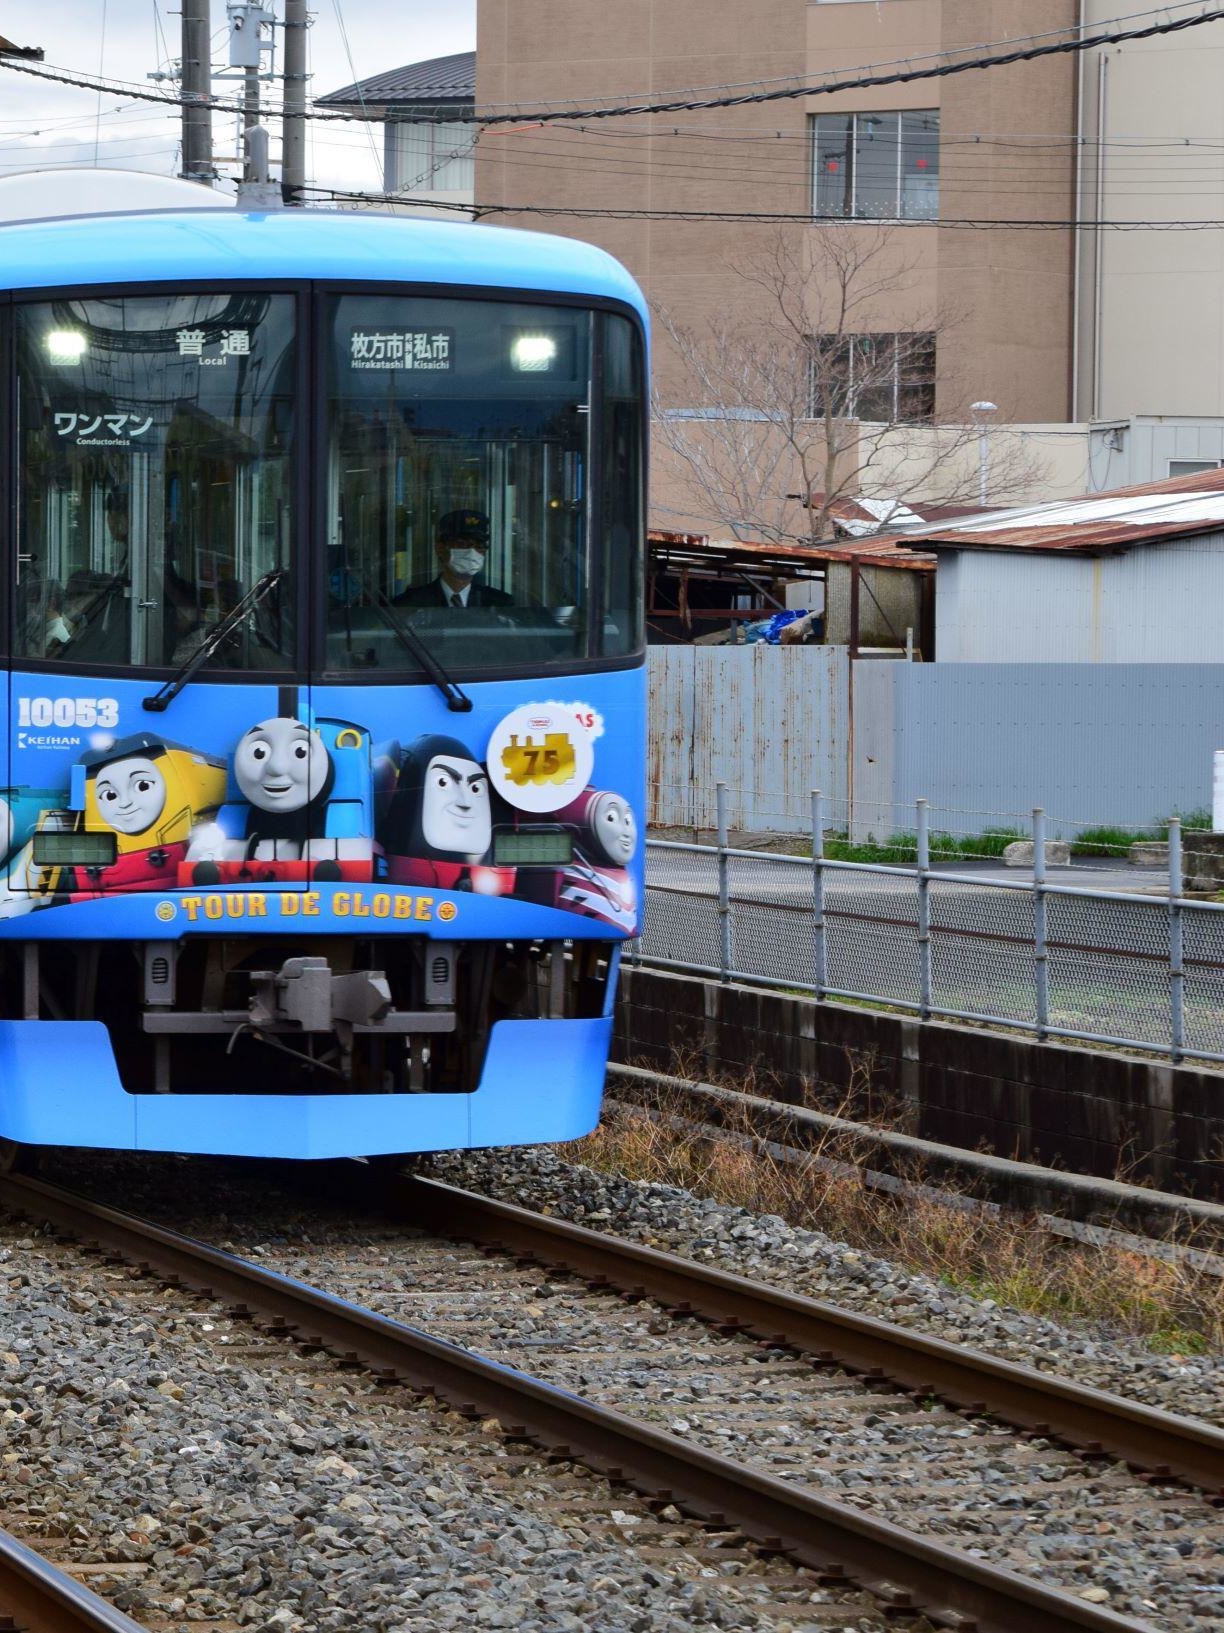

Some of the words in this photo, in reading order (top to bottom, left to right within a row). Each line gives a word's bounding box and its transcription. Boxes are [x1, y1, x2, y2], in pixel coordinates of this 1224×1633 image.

[176, 329, 251, 355] 普通
[351, 333, 404, 359] 枚方市
[414, 333, 450, 359] 私市
[199, 357, 227, 366] Local
[351, 360, 404, 369] Hirakatashi
[414, 360, 450, 369] Kisaichi
[54, 413, 154, 436] ワンマン
[76, 438, 131, 446] Conductorless
[18, 697, 119, 728] 10053
[28, 736, 80, 745] KEIHAN
[524, 750, 561, 775] 75
[181, 892, 267, 921] TOUR
[280, 892, 320, 916] DE
[332, 892, 434, 921] GLOBE
